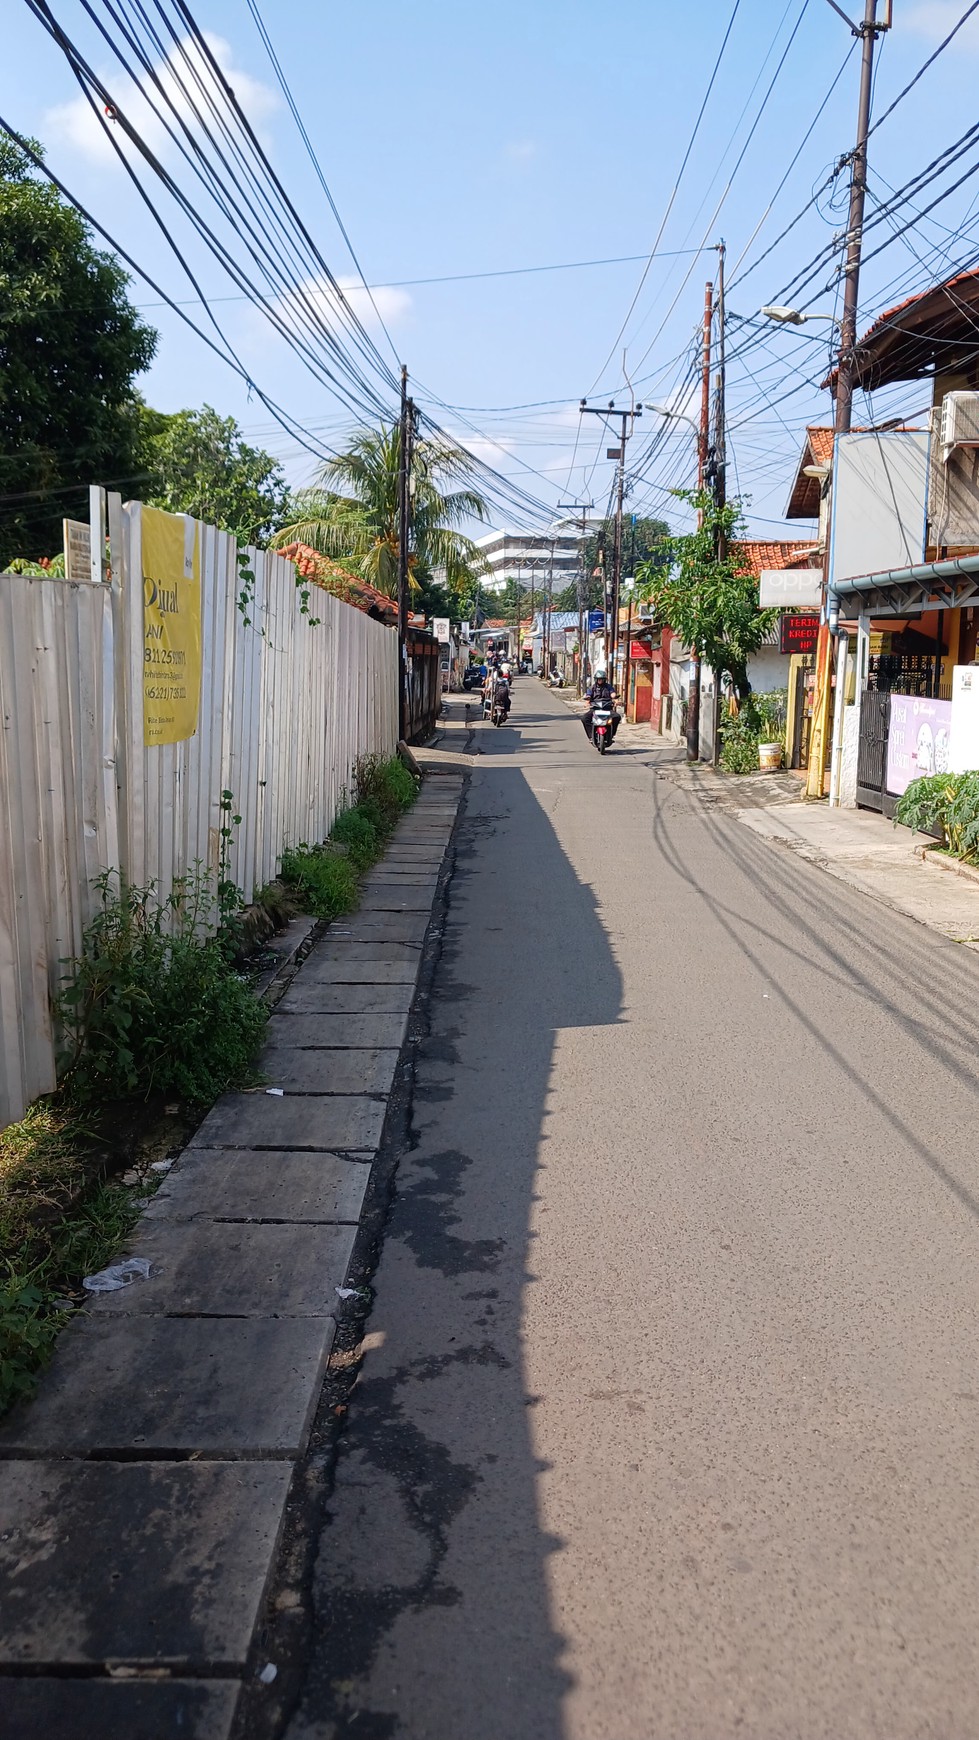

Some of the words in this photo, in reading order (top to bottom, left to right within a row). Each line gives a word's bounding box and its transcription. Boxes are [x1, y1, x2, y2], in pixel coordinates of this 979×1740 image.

[144, 577, 178, 618] Dijual
[790, 618, 820, 627] TERIM
[800, 640, 813, 649] HP
